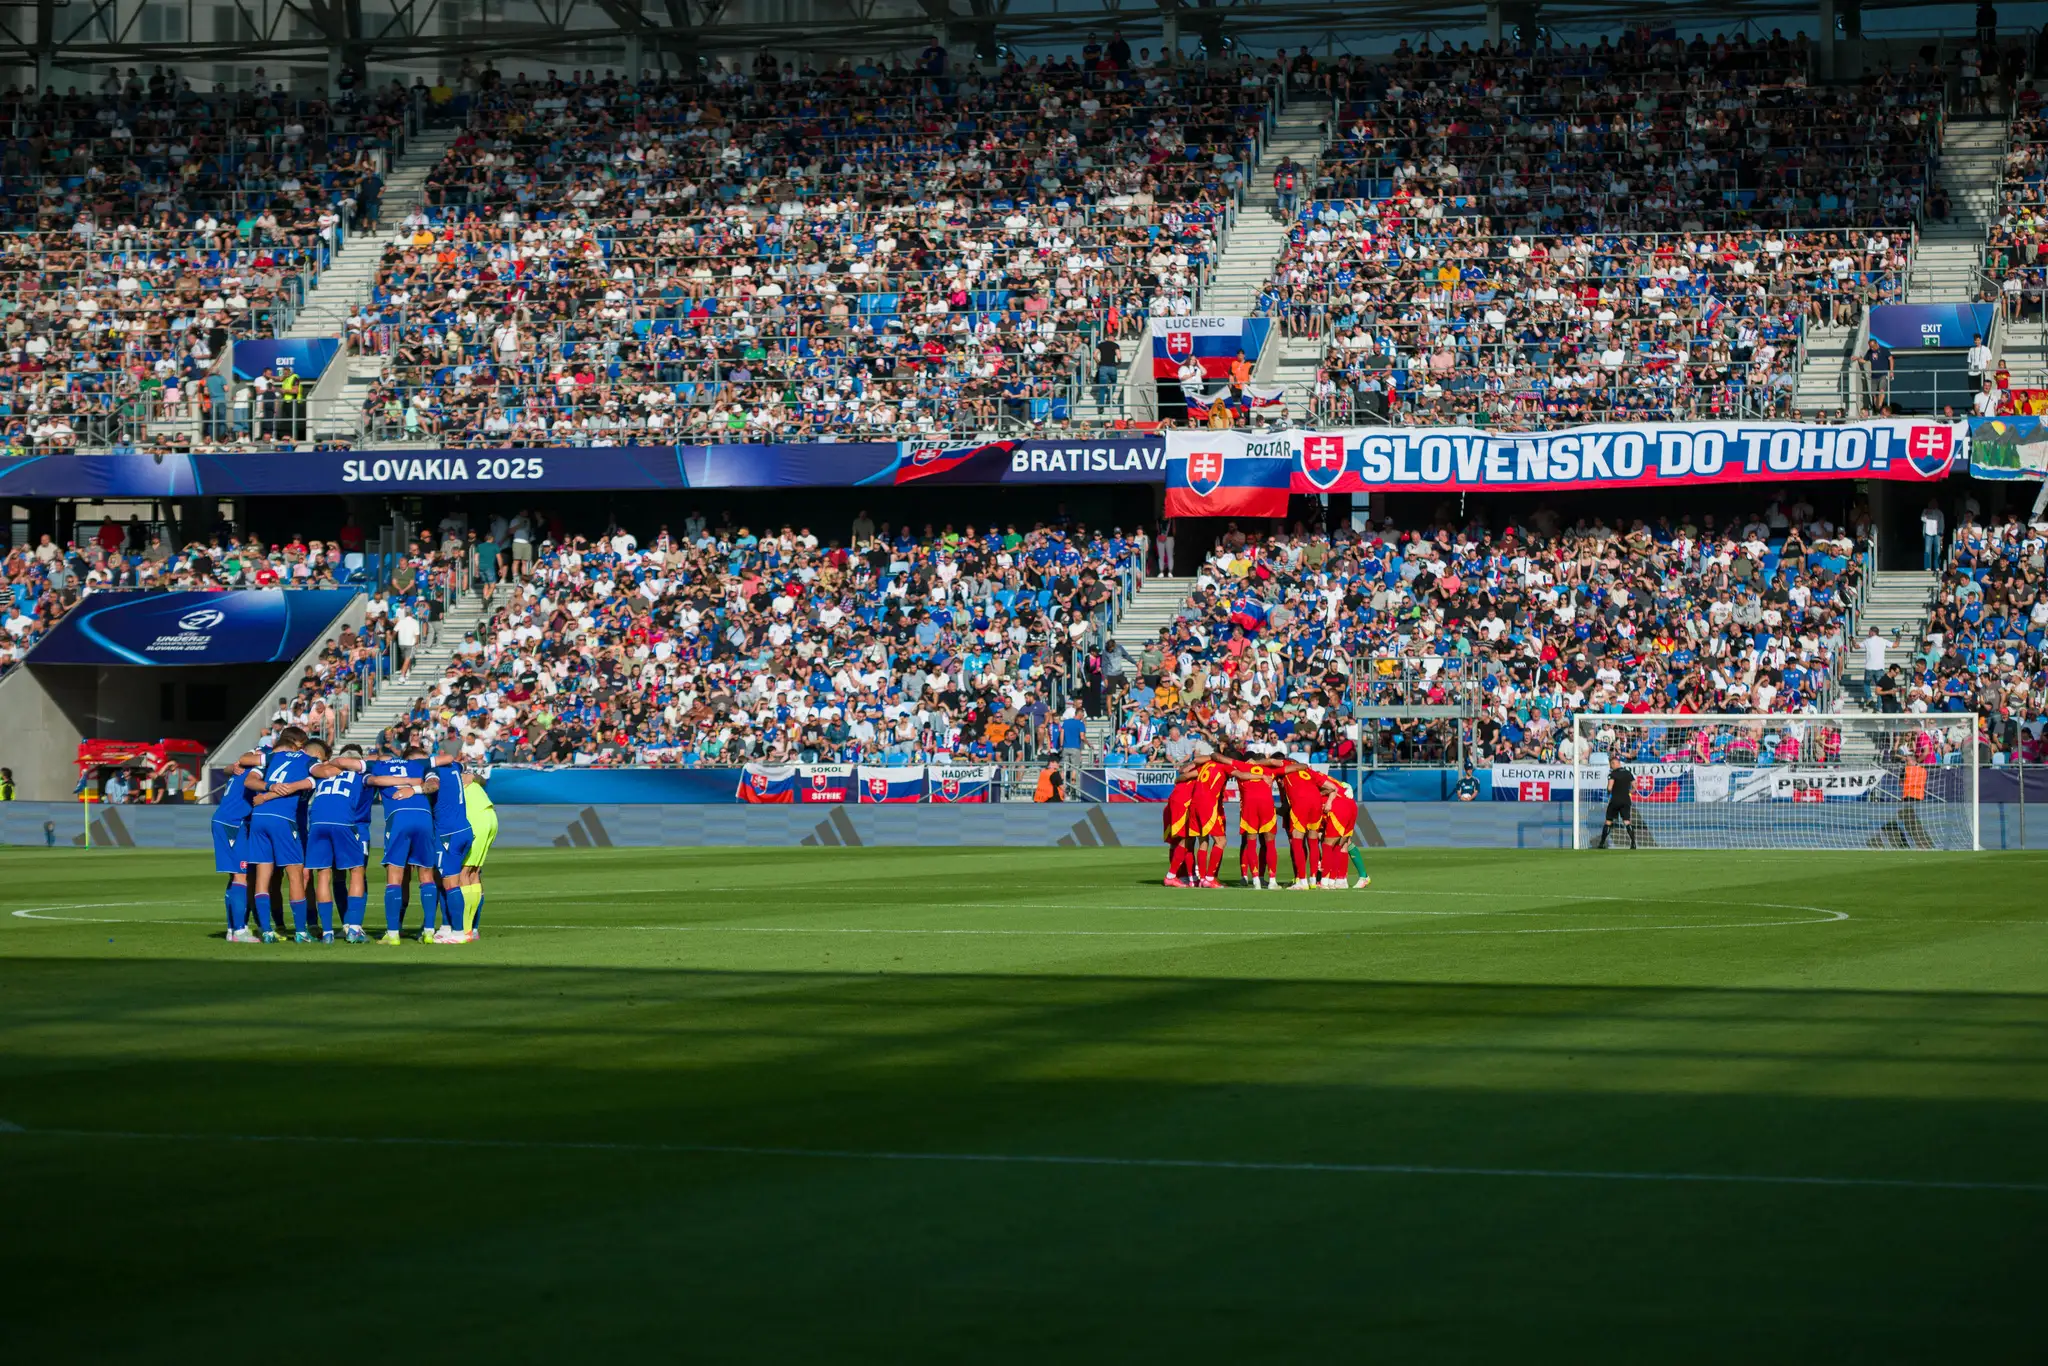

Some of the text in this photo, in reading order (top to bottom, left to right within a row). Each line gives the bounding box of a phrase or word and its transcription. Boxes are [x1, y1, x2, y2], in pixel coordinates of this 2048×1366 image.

[1920, 324, 1942, 333] EXIT
[275, 357, 296, 365] EXIT
[1246, 438, 1291, 457] POLTÁR
[1361, 429, 1892, 483] SLOVENSKO DO TOHO!
[342, 458, 544, 482] SLOVAKIA 2025
[268, 760, 292, 784] 4
[811, 766, 843, 774] SOKOL
[1502, 769, 1601, 780] LEHOTA PRI NTRE
[315, 771, 356, 797] 22
[1136, 772, 1175, 784] TURANY
